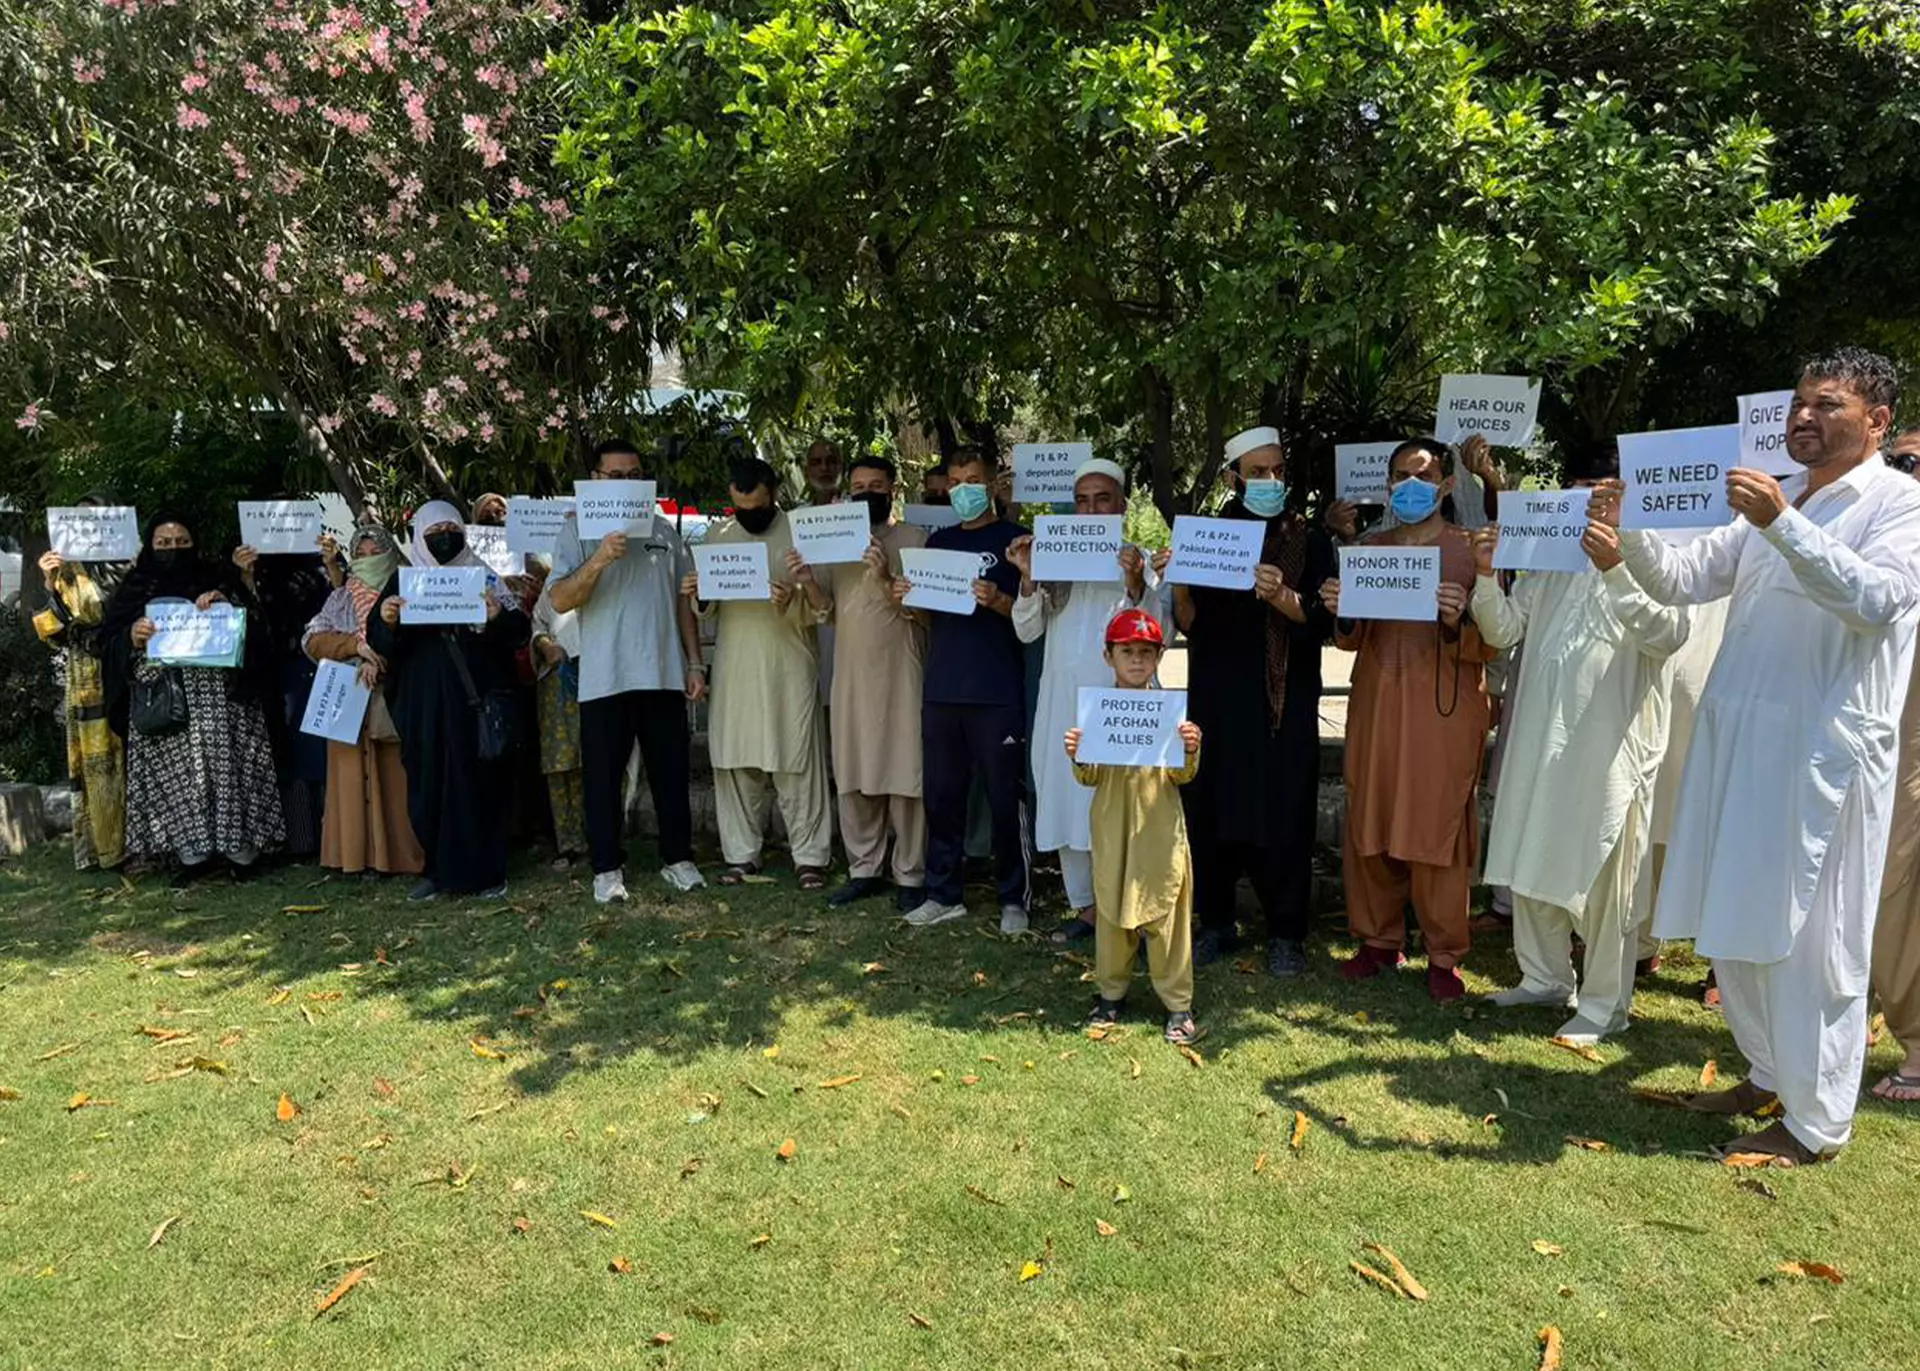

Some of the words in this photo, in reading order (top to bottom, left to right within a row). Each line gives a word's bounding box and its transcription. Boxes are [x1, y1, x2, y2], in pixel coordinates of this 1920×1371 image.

[1450, 399, 1489, 411] HEAR
[1493, 400, 1526, 413] OUR
[1750, 405, 1784, 425] GIVE
[1458, 417, 1511, 431] VOICES
[1755, 434, 1788, 451] HOP
[1035, 453, 1045, 461] P1
[1047, 453, 1055, 461] &
[1058, 453, 1069, 461] P2
[1635, 467, 1663, 485] WE
[1669, 464, 1719, 482] NEED
[1024, 484, 1039, 492] risk
[1041, 484, 1073, 492] Pakista
[1525, 502, 1555, 513] TIME
[1557, 502, 1570, 513] IS
[1642, 493, 1713, 512] SAFETY
[585, 511, 619, 519] AFGHAN
[621, 511, 649, 519] ALLIES
[1047, 525, 1068, 536] WE
[1071, 525, 1106, 536] NEED
[1195, 530, 1206, 538] P1
[1208, 531, 1215, 539] &
[1218, 532, 1230, 540] P2
[1502, 525, 1558, 537] RUNNING
[1036, 542, 1118, 553] PROTECTION
[1179, 544, 1216, 554] Pakistan
[1217, 547, 1237, 556] face
[1238, 550, 1250, 558] an
[1176, 560, 1217, 570] uncertain
[1219, 562, 1247, 572] future
[1347, 557, 1399, 569] HONOR
[1403, 557, 1432, 570] THE
[709, 568, 747, 576] education
[1356, 576, 1421, 589] PROMISE
[320, 699, 328, 709] P2
[1101, 699, 1164, 712] PROTECT
[1103, 717, 1159, 728] AFGHAN
[1108, 734, 1154, 745] ALLIES
